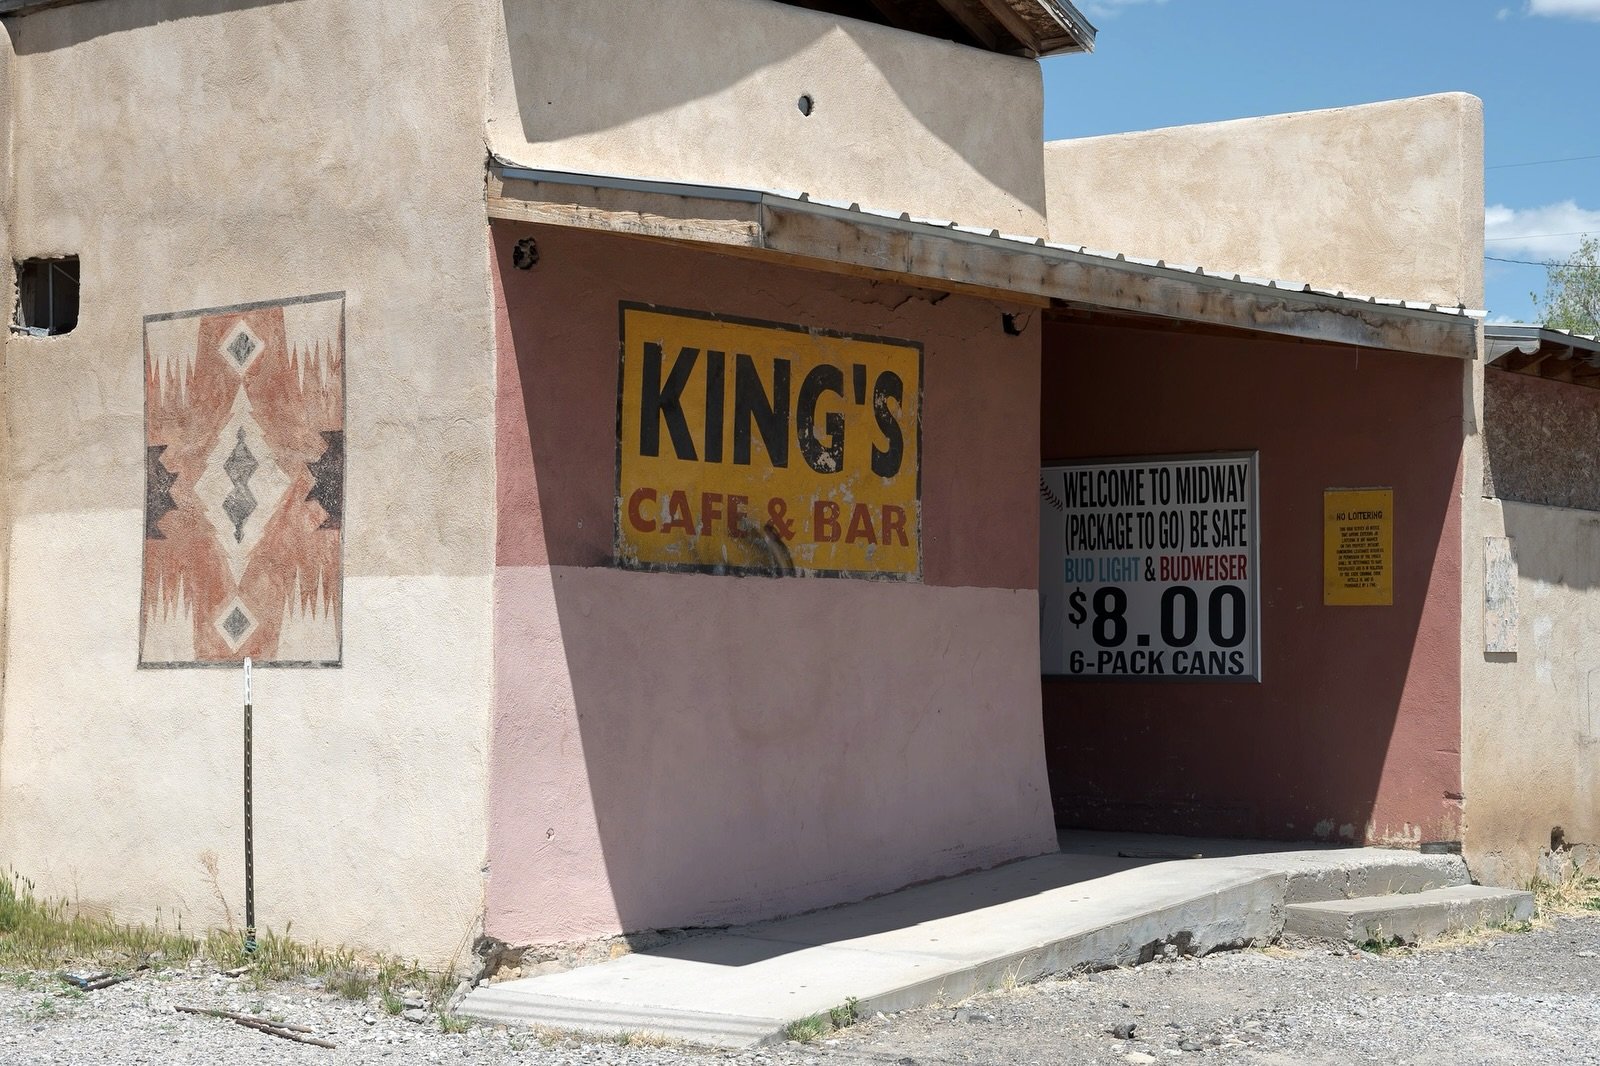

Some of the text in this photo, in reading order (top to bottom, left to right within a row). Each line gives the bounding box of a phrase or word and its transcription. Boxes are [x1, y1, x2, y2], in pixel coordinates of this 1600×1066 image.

[639, 341, 904, 478] KING'S
[1063, 464, 1248, 508] WELCOME TO MIDWAY
[627, 487, 910, 547] CAFE & BAR
[1065, 509, 1247, 555] (PACKAGE TO GO) BE SAFE
[1336, 511, 1383, 521] NO LOITERING
[1065, 554, 1248, 583] BUD LIGHT & BUDWEISER
[1068, 585, 1247, 648] $8.00
[1069, 650, 1244, 675] 6-PACK CANS
